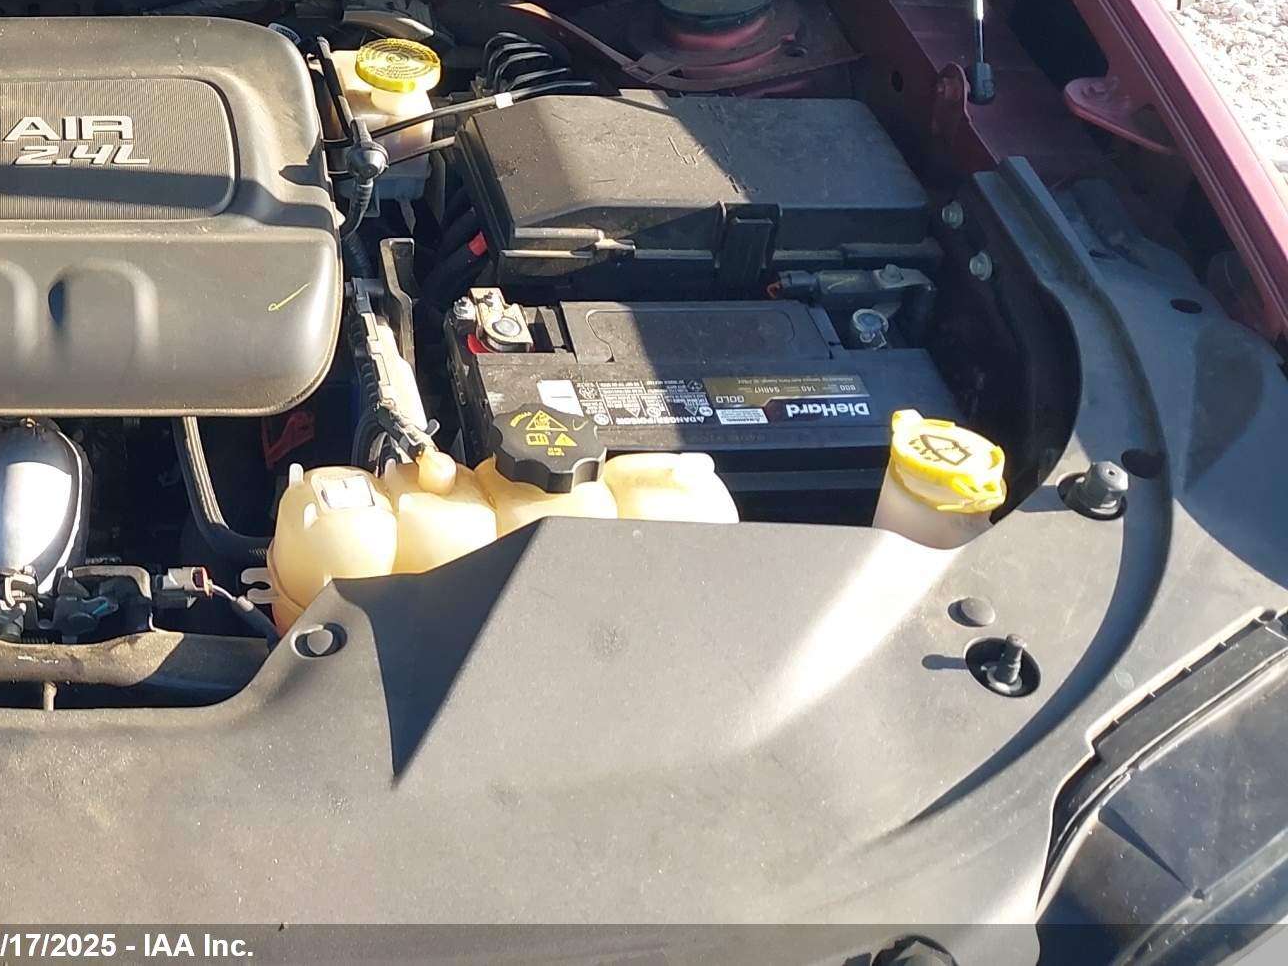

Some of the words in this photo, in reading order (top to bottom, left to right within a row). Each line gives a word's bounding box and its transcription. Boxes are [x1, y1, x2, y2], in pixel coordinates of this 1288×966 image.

[13, 144, 150, 166] 2.4L
[715, 395, 745, 404] GOLD
[785, 402, 870, 417] DieHard
